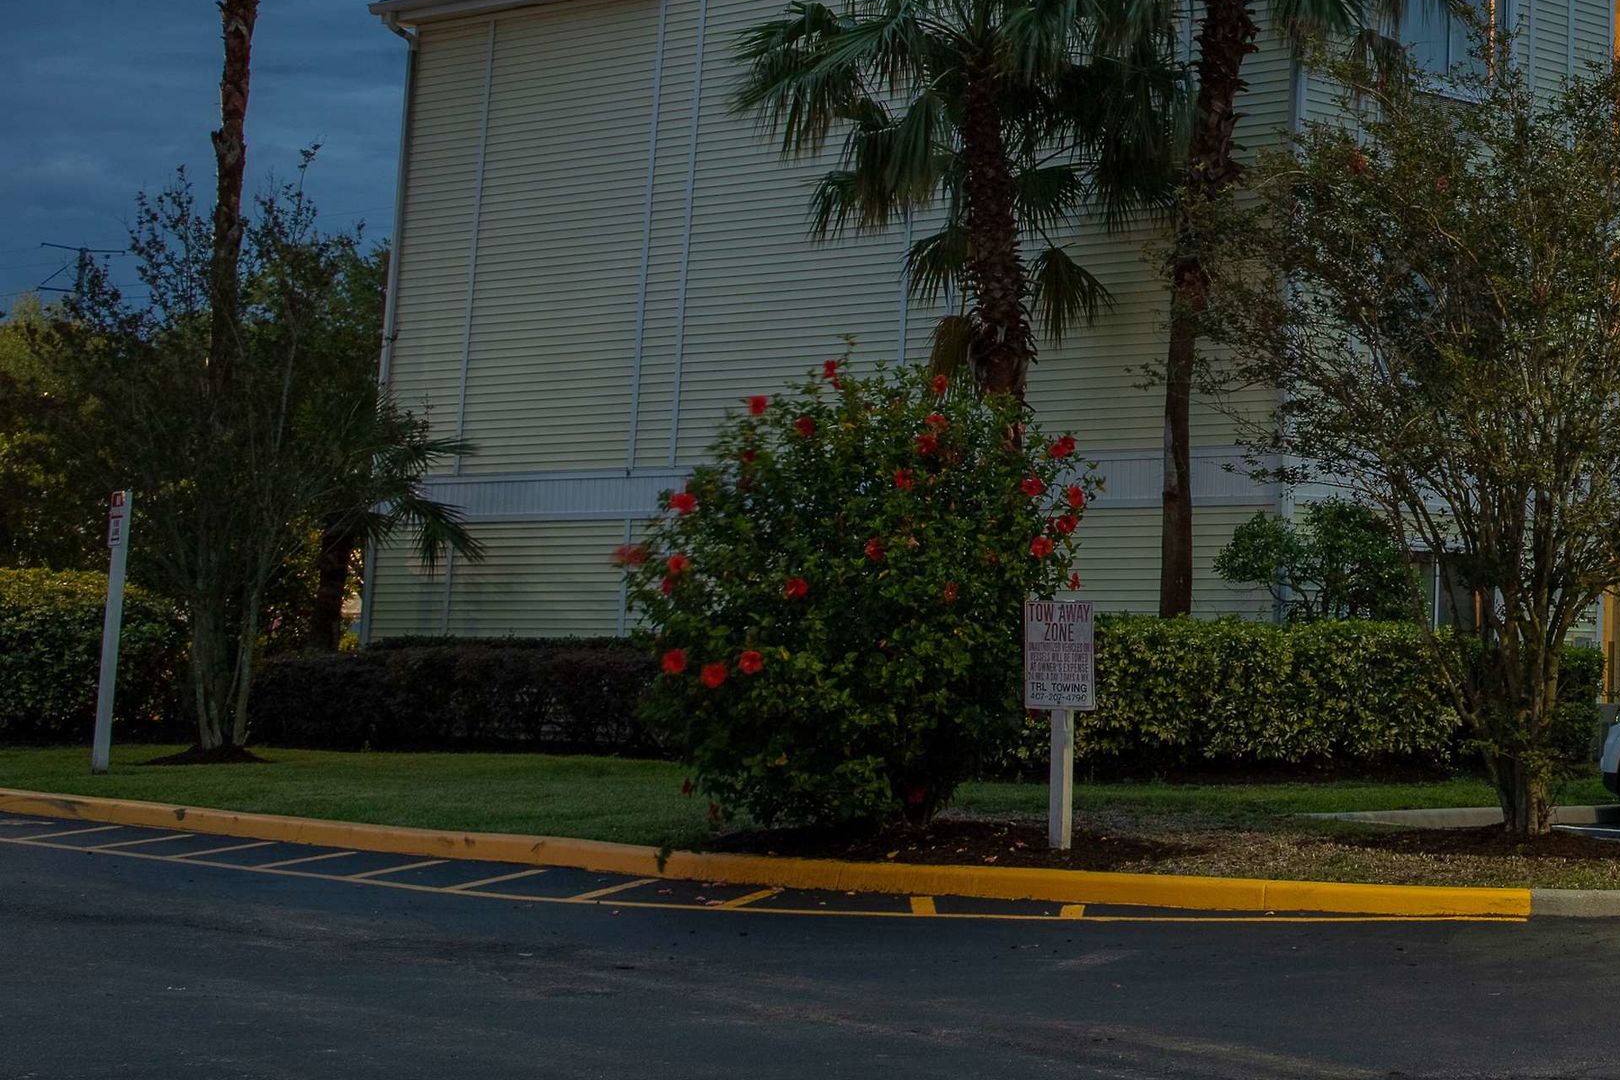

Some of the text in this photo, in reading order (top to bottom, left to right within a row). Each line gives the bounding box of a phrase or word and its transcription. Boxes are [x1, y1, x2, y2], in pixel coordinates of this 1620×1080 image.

[1029, 603, 1090, 623] TOW AWAY
[1044, 622, 1074, 641] ZONE
[1051, 682, 1087, 693] TOWING
